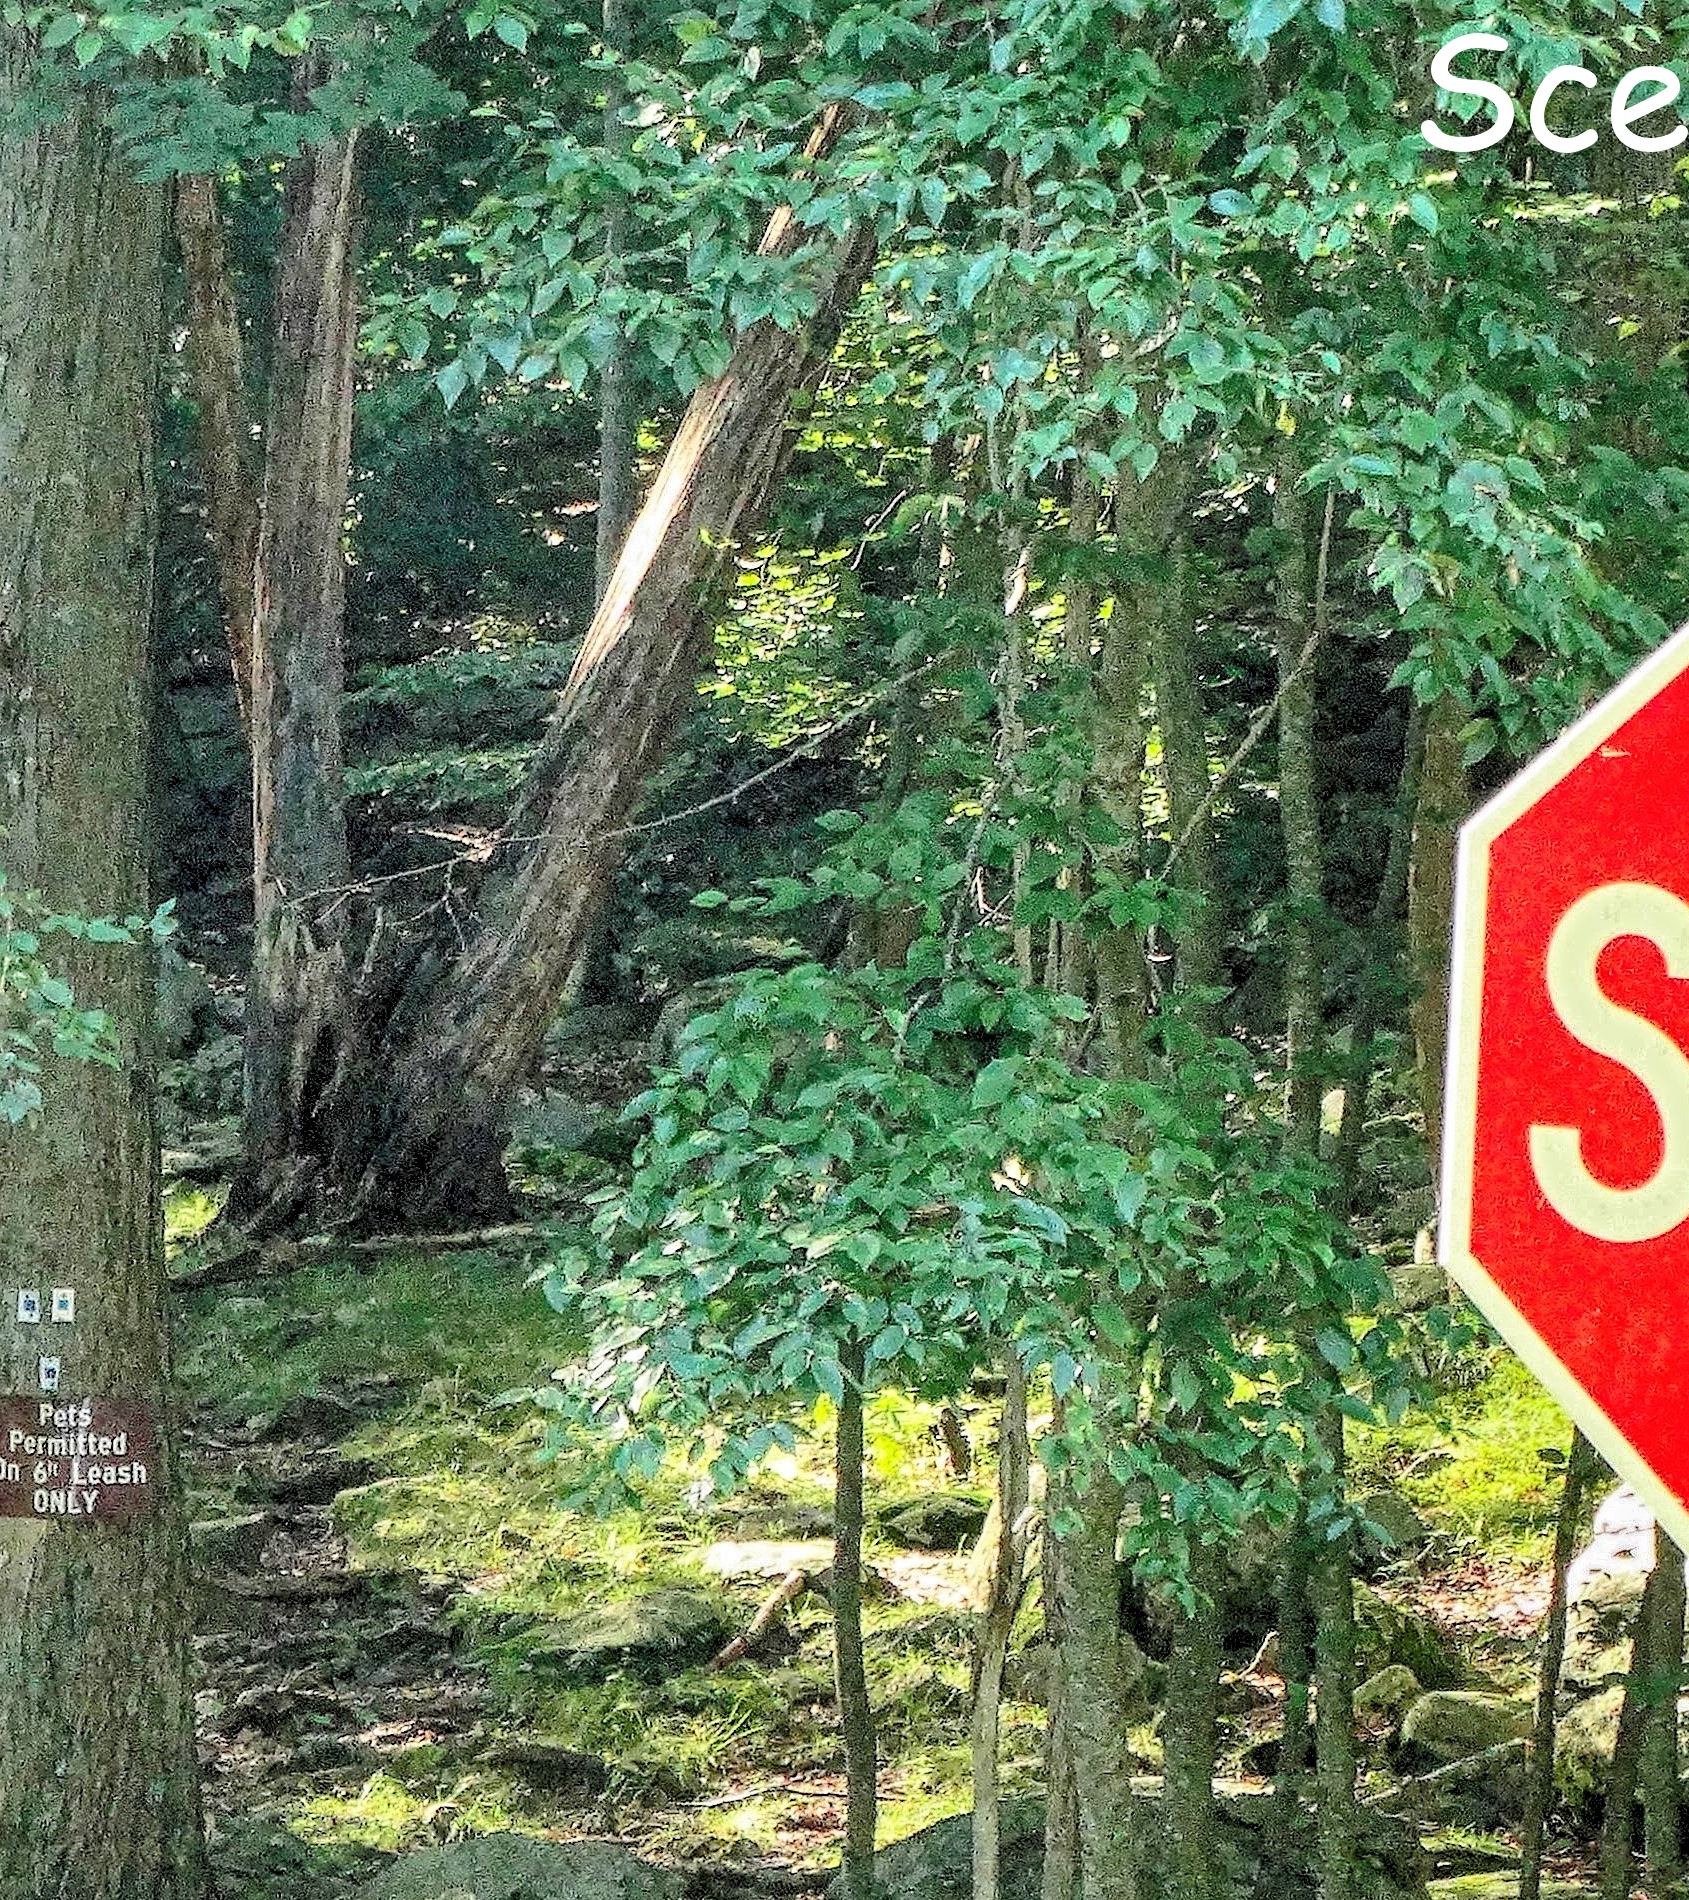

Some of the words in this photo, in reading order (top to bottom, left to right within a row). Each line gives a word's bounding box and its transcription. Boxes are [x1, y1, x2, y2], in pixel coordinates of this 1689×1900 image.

[39, 1402, 92, 1428] Pets
[9, 1429, 128, 1456] Permitted
[70, 1456, 147, 1485] Leash
[33, 1488, 99, 1514] ONLY
